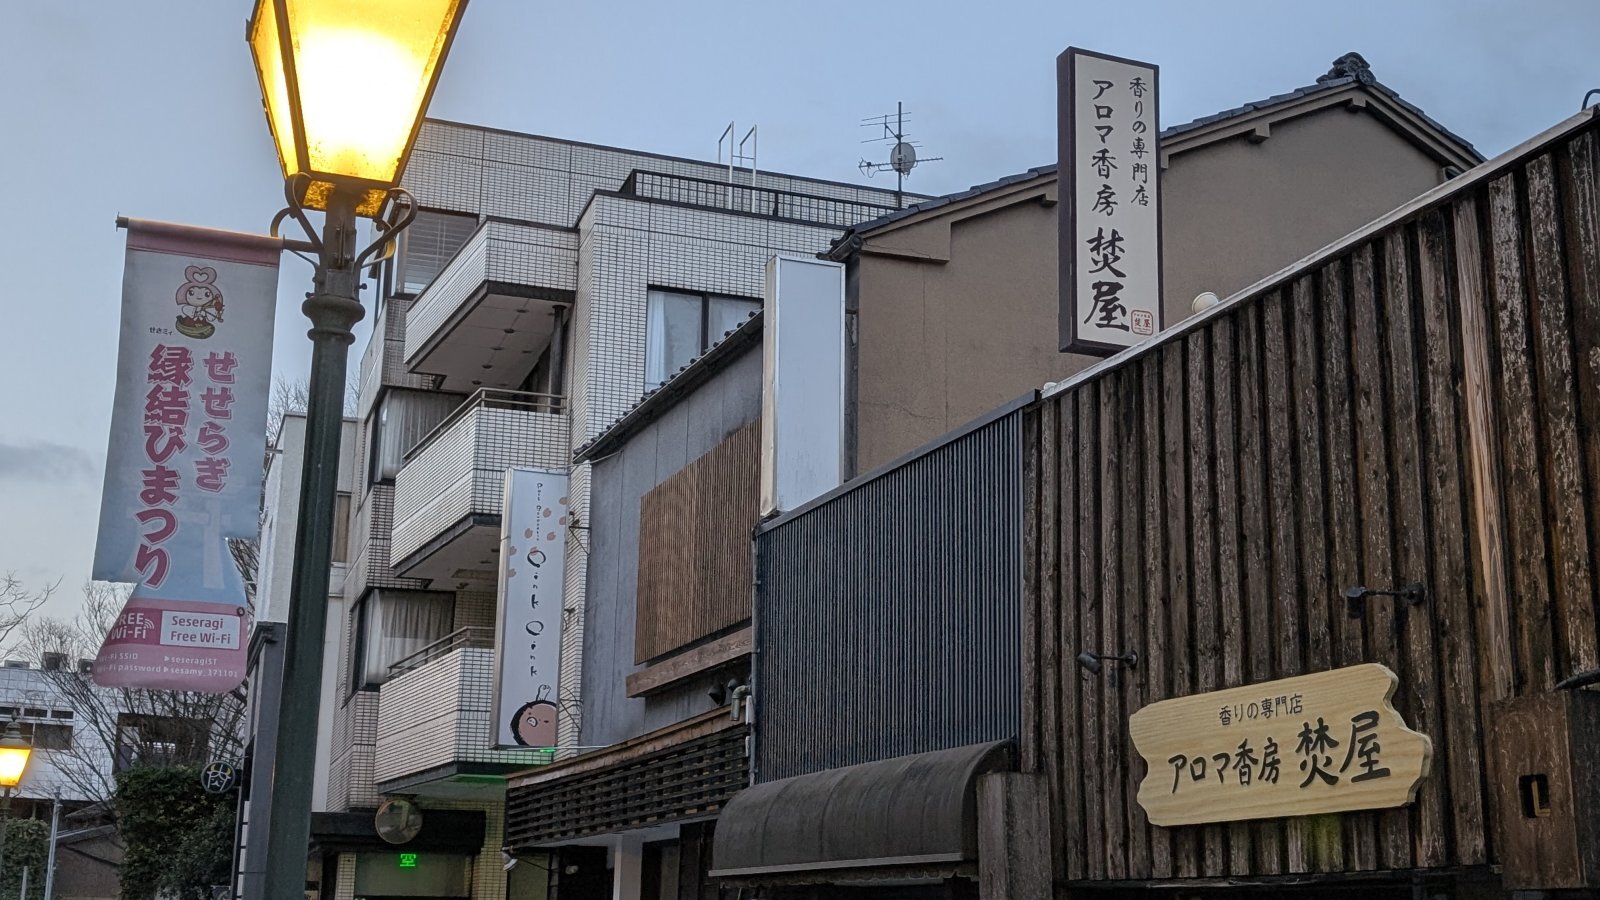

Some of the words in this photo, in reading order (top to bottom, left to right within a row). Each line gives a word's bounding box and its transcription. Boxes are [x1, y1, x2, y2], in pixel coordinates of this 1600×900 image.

[1129, 76, 1149, 207] 香りの専門店
[193, 351, 238, 493] せせらぎ
[134, 343, 194, 589] 縁結びまつり
[118, 612, 145, 625] REE
[171, 615, 224, 631] Seseragi
[170, 630, 197, 642] Free
[200, 632, 231, 644] Wi-Fi
[118, 664, 161, 673] password
[1218, 694, 1303, 726] 香りの専門店
[400, 853, 416, 867] 空
